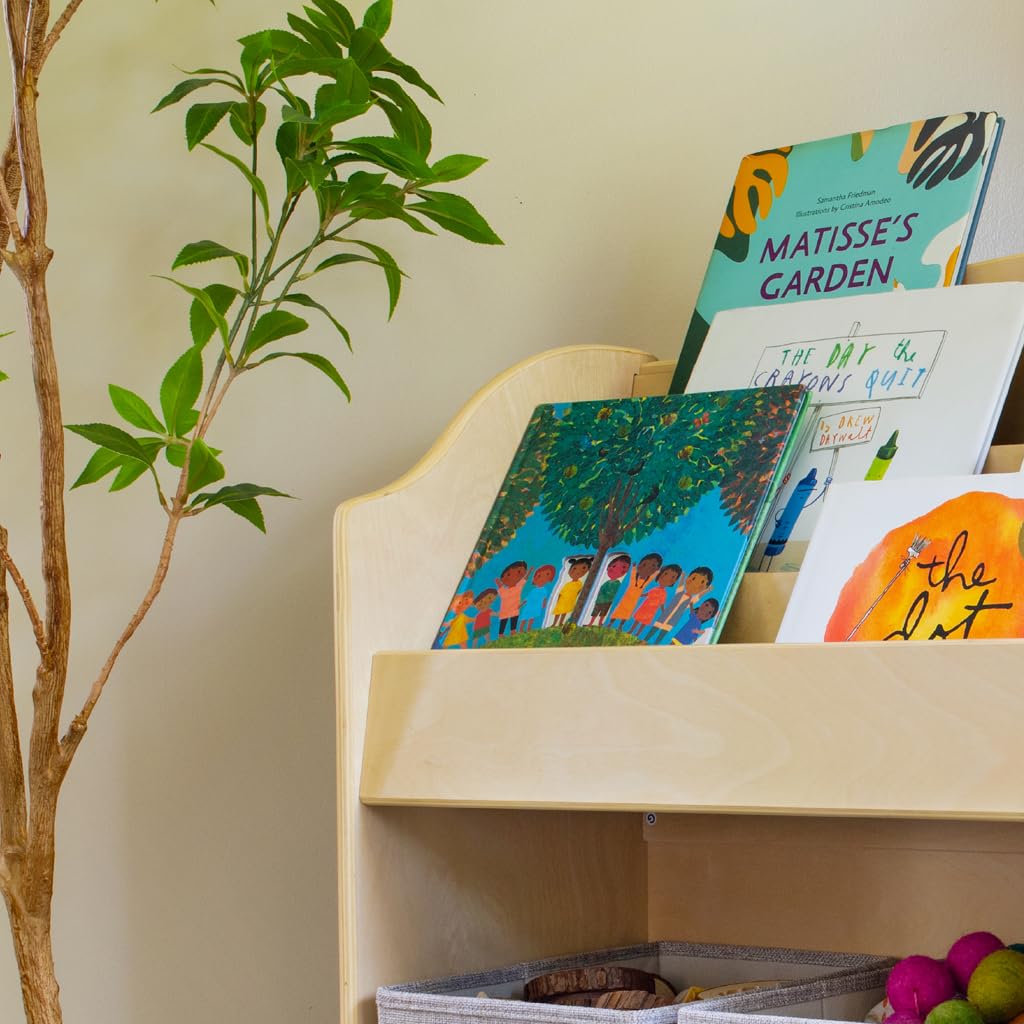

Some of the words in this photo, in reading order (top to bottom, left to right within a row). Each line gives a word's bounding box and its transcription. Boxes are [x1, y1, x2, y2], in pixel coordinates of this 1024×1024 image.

[816, 193, 846, 205] Samantha
[847, 189, 876, 200] Friedman
[830, 205, 839, 213] by
[864, 197, 892, 207] Amodeo
[759, 212, 920, 264] MATISSE'S
[759, 256, 895, 300] GARDEN
[781, 347, 817, 367] THE
[825, 342, 877, 369] DAY
[893, 337, 918, 363] the
[753, 368, 853, 393] CRAYONS
[865, 367, 927, 399] QUIT
[838, 414, 874, 429] DREW
[916, 529, 998, 593] the
